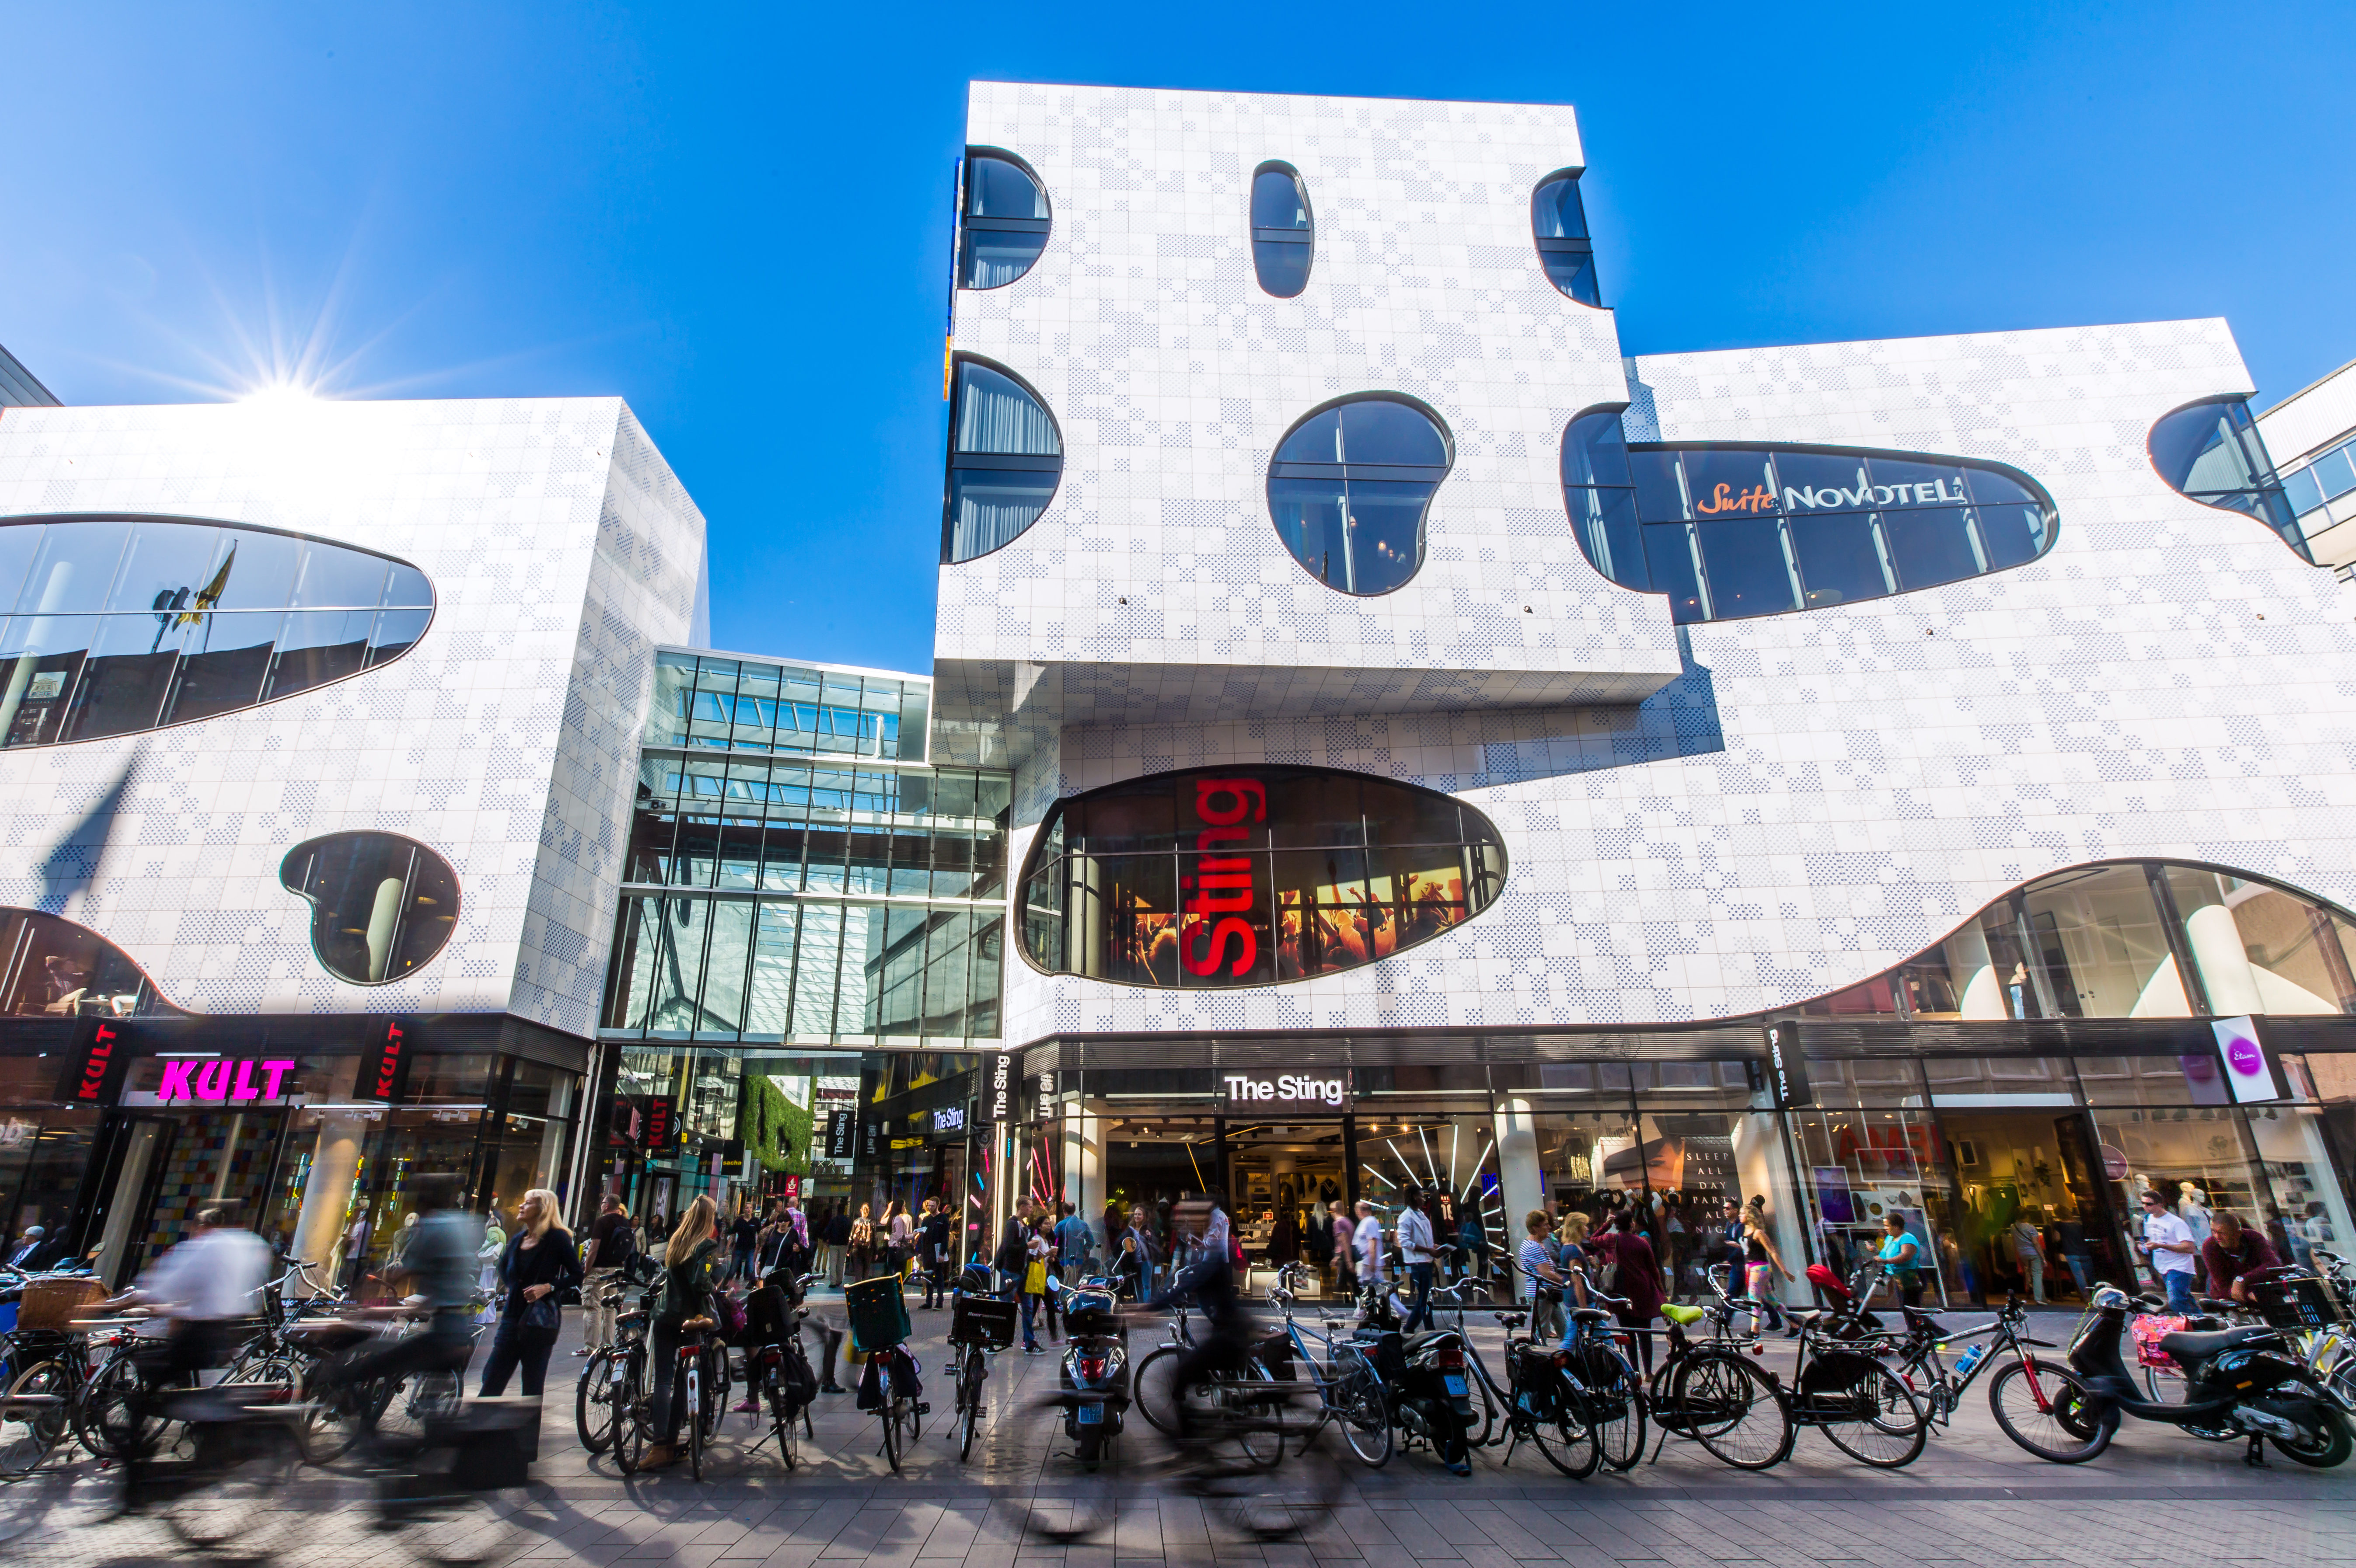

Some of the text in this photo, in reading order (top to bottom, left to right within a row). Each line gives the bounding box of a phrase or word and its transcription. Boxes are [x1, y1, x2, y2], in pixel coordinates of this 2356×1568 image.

[1698, 479, 1964, 513] Suite NOVOTEL
[1181, 778, 1266, 977] Sting
[79, 1024, 116, 1098] KULT
[376, 1022, 403, 1096] KULT
[1769, 1029, 1789, 1101] The Sting
[2234, 1051, 2255, 1060] Etam
[158, 1060, 294, 1100] KULT
[993, 1055, 1010, 1118] The Sting
[1224, 1075, 1343, 1105] The Sting
[648, 1099, 668, 1146] KULT
[834, 1113, 847, 1155] The Sting
[934, 1107, 963, 1130] The Sting
[1686, 1153, 1729, 1161] SLEEP
